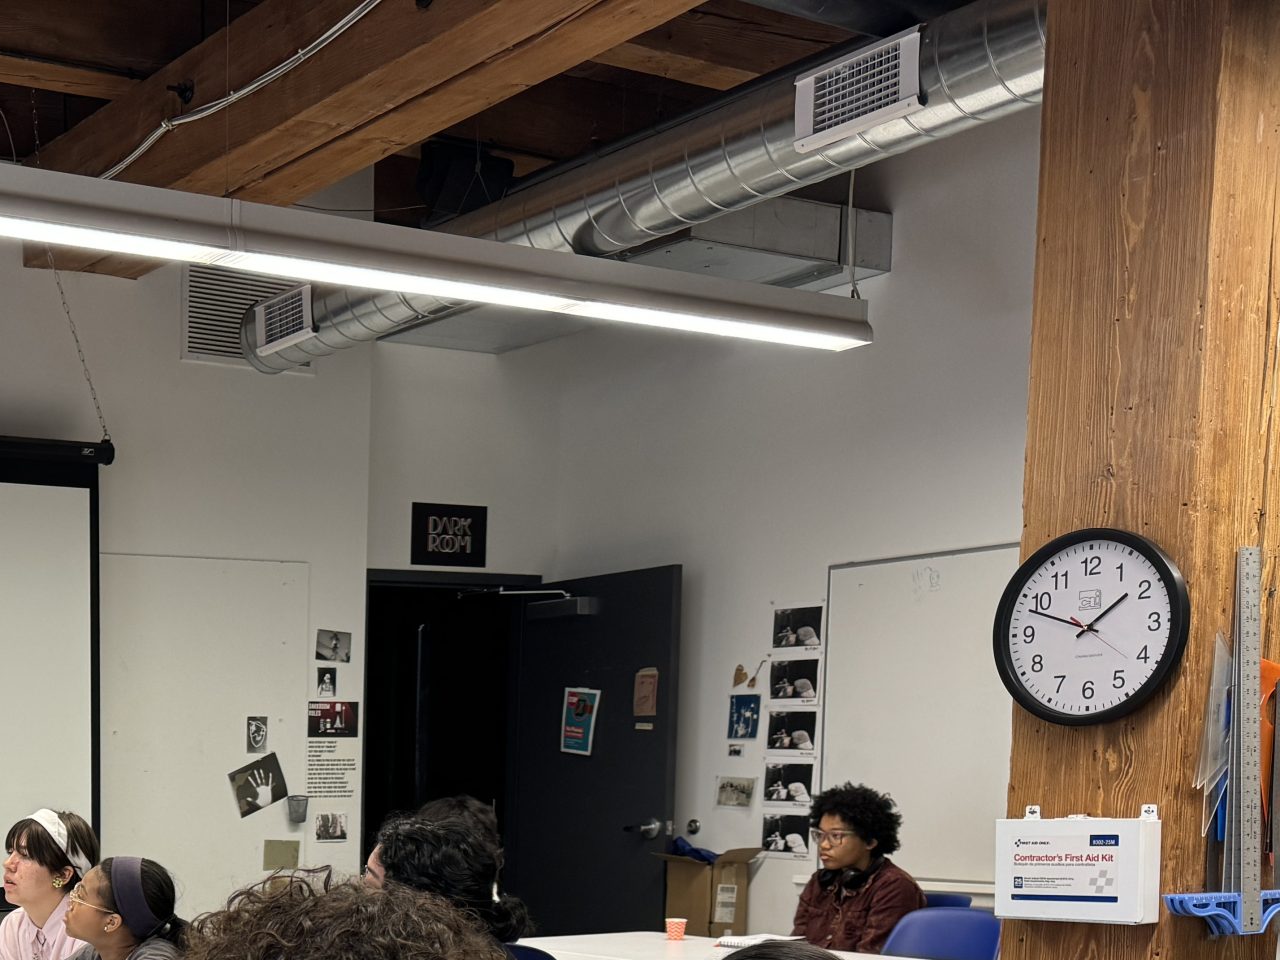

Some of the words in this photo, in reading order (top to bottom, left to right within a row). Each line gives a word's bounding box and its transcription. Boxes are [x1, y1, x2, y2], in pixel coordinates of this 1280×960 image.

[427, 516, 472, 535] DARK
[427, 535, 471, 553] ROOM
[1081, 556, 1102, 577] 12
[1116, 563, 1124, 582] 1
[1051, 570, 1069, 590] 11
[1138, 580, 1152, 600] 2
[1031, 592, 1052, 611] 10
[1147, 612, 1161, 631] 3
[1023, 626, 1035, 644] 9
[1031, 655, 1044, 673] 8
[1136, 645, 1150, 664] 4
[1053, 675, 1067, 694] 7
[1112, 670, 1125, 689] 5
[1082, 681, 1095, 699] 6
[1013, 854, 1063, 862] Contractor's
[1065, 854, 1084, 862] First
[1085, 854, 1099, 862] Aid
[1101, 854, 1114, 862] Kit
